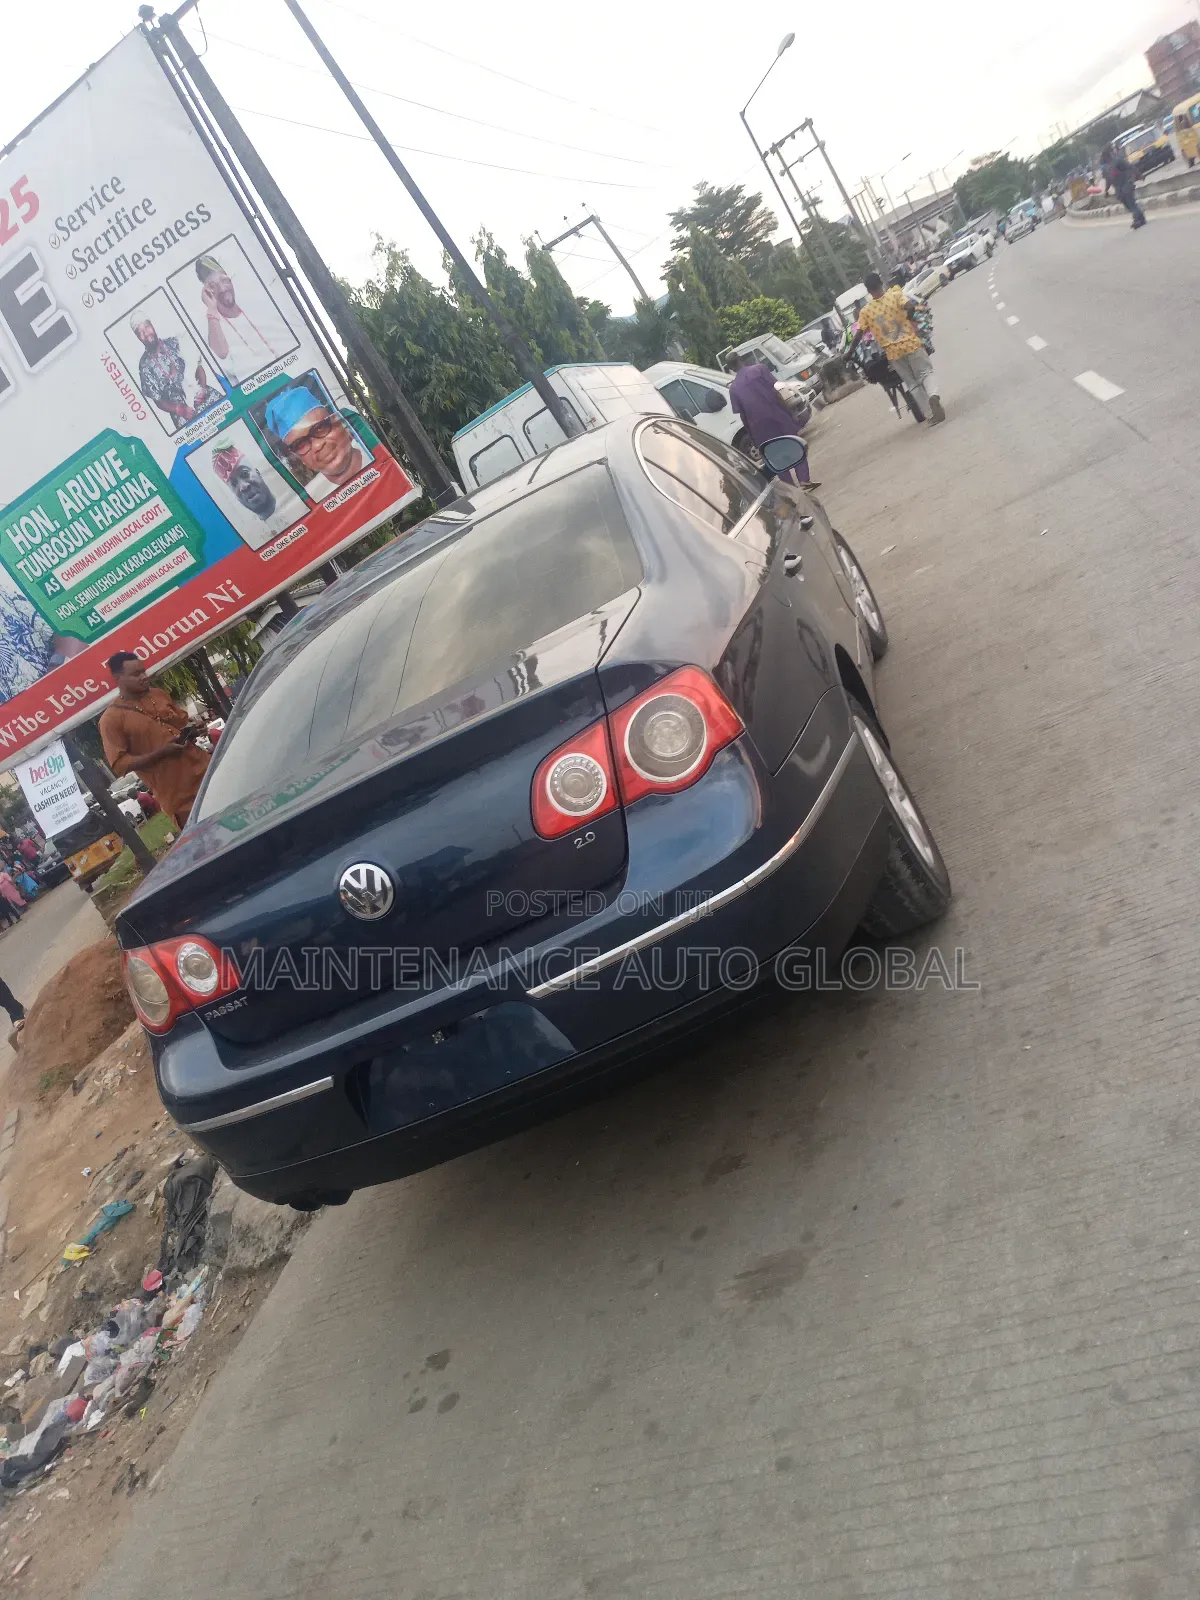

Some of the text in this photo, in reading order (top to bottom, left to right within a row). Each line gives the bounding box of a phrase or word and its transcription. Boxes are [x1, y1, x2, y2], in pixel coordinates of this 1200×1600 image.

[54, 176, 126, 242] Service
[71, 197, 157, 273] Sacrifice
[89, 203, 212, 303] Selflessness
[100, 350, 147, 421] COURTESY:
[5, 447, 131, 556] HON. ARUWE
[15, 471, 158, 583] TUNBOSUN HARUNA
[289, 525, 307, 541] AGIRI
[43, 503, 166, 597] AS CHAIRMAN MUSHIN LOCAL GOVT.
[55, 600, 80, 621] HON.
[74, 585, 101, 608] SEMIU
[98, 566, 127, 593] ISHOLA
[86, 611, 101, 627] AS
[99, 604, 112, 616] VICE
[110, 585, 139, 609] CHAIRMAN
[136, 573, 159, 592] MUSHIN
[156, 561, 175, 578] LOCAL
[0, 714, 50, 748] Wibe
[44, 678, 110, 716] Jebe,
[203, 579, 245, 614] Ni
[33, 794, 60, 813] CASHIER
[204, 996, 249, 1021] PASSAT
